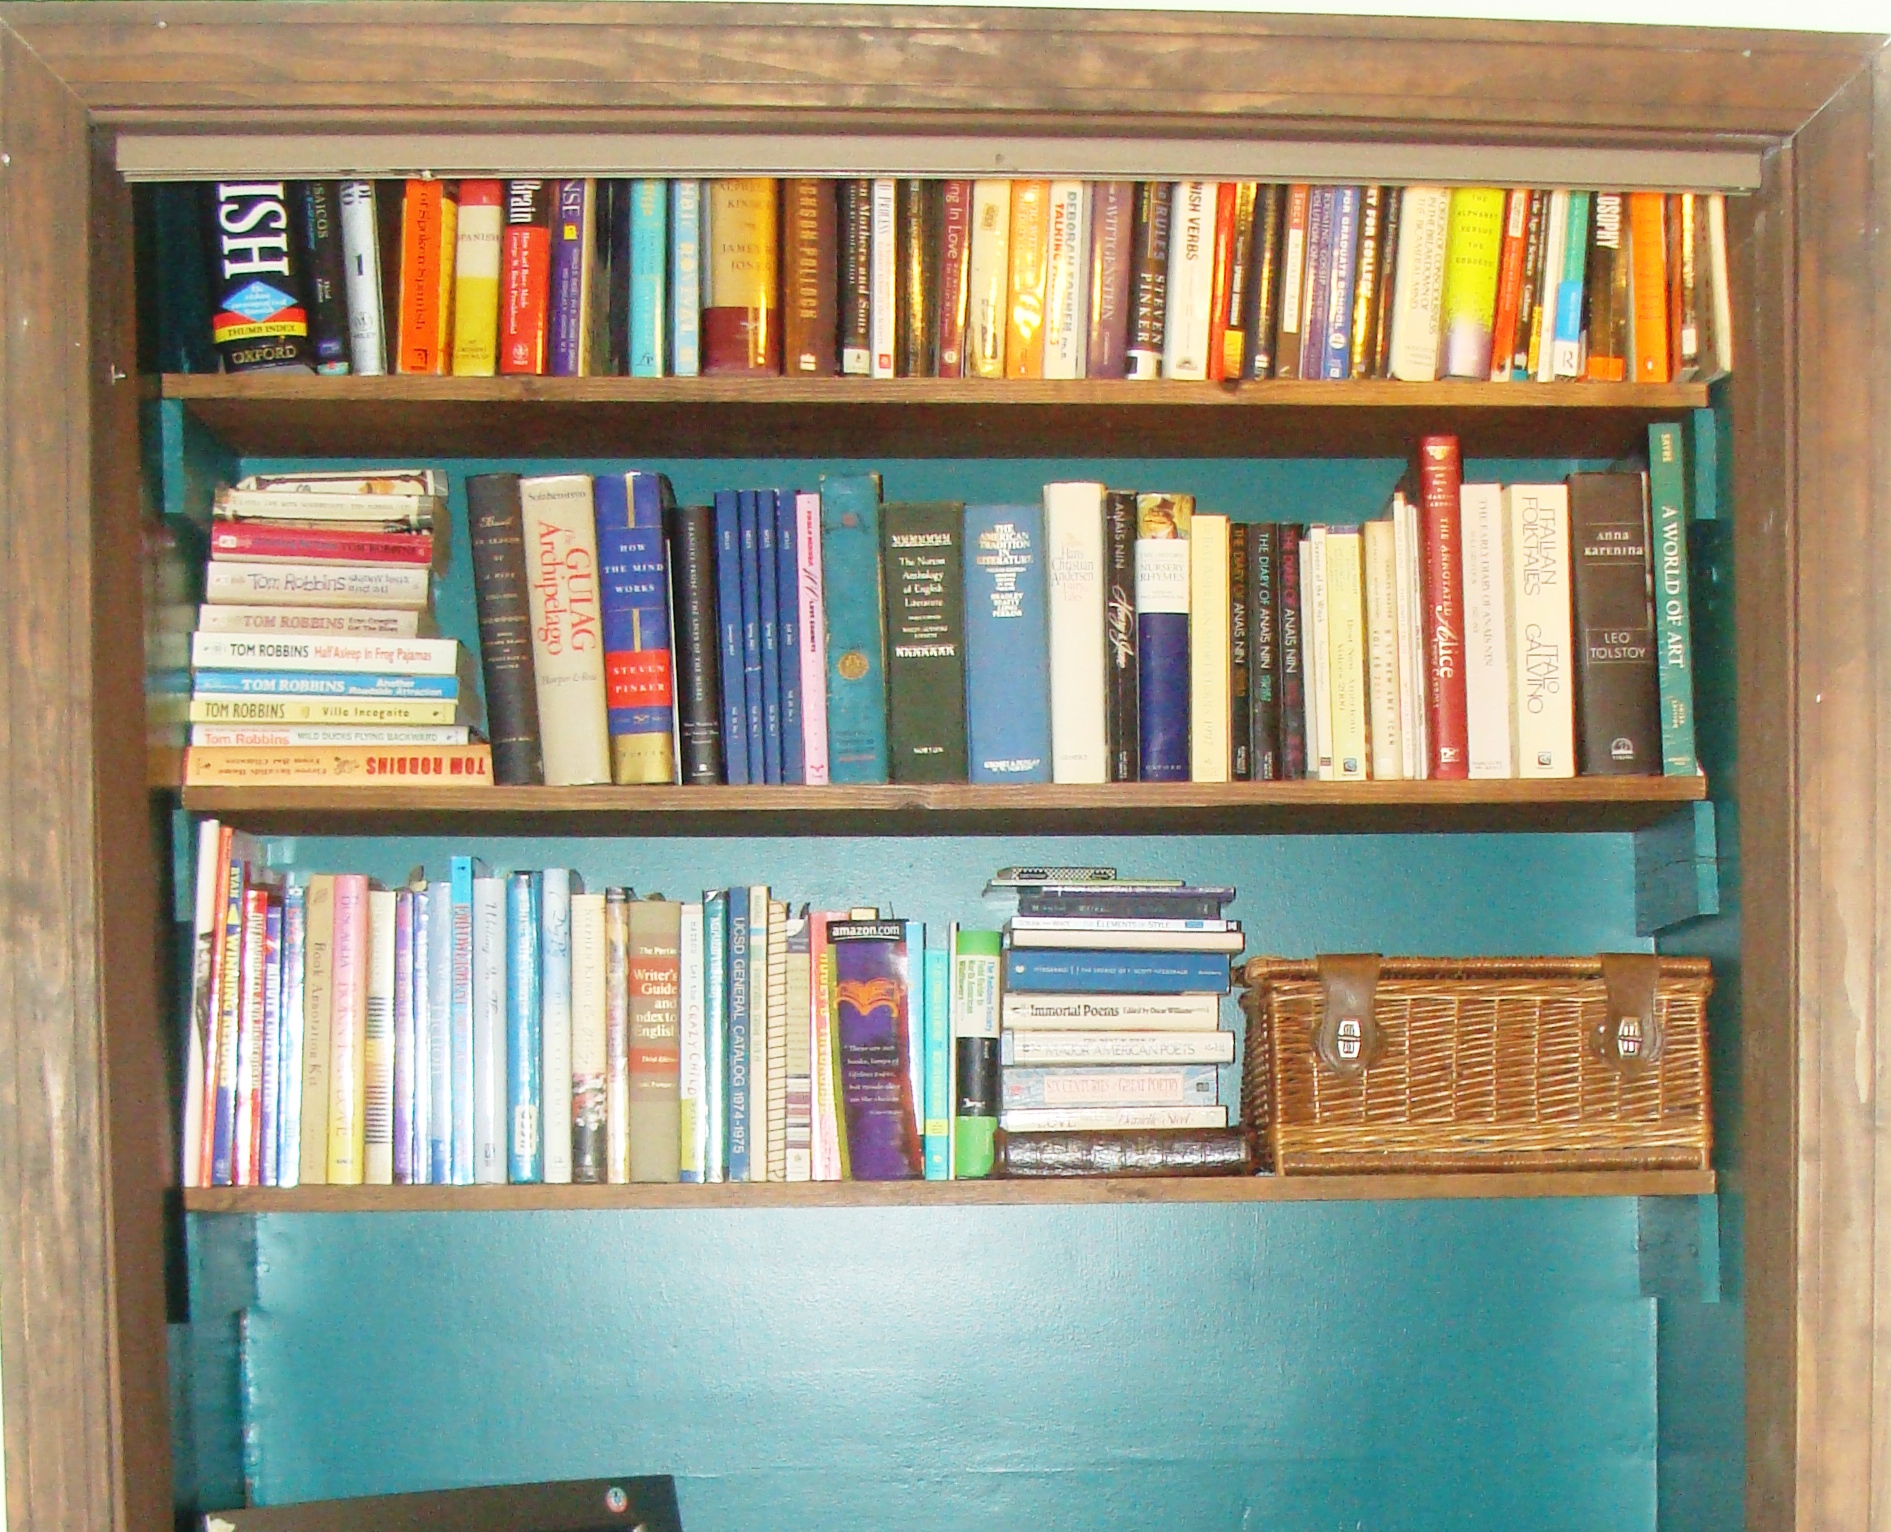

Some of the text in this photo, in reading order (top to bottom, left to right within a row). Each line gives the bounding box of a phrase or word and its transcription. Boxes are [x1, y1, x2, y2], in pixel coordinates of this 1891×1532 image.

[509, 180, 542, 223] Brain
[950, 208, 962, 220] In
[1595, 196, 1621, 249] OSOPHY
[1065, 191, 1078, 267] DEBORAH
[1185, 217, 1201, 262] VERBS
[946, 224, 962, 260] Love
[1359, 209, 1376, 298] FOR COLLEGE
[413, 211, 431, 331] Spoken Spanish
[857, 203, 871, 335] Mothers and Sons
[1333, 190, 1353, 330] FOR GRADUATE SCHOOL
[799, 247, 818, 319] POLLOCK
[1137, 273, 1153, 343] PINKER
[1151, 274, 1166, 345] STEVEN
[231, 345, 297, 365] OXFORD
[619, 543, 647, 553] HOW
[1258, 533, 1269, 553] THE
[1522, 497, 1541, 597] FOLKTALES
[1539, 508, 1558, 586] ITALIAN
[605, 563, 664, 574] THE MIND
[899, 557, 915, 567] The
[1114, 544, 1126, 569] NIN
[248, 572, 346, 592] Tom Robbins
[1258, 556, 1269, 588] DIARY
[535, 521, 567, 657] Archipelago
[615, 583, 656, 594] WORKS
[1435, 517, 1460, 679] THE ANNOTATED Alice
[1661, 505, 1685, 669] A WORLD OF ART
[565, 547, 596, 652] GULAG
[244, 614, 345, 630] TOM ROBBINS
[230, 643, 256, 657] TOM
[259, 642, 309, 658] ROBBINS
[1603, 633, 1631, 645] LEO
[1233, 640, 1245, 664] NIN
[1259, 646, 1270, 669] NIN
[1285, 649, 1298, 673] NIN
[1589, 647, 1646, 660] TOLSTOY
[614, 663, 665, 674] STEVEN
[1525, 624, 1545, 714] CALVINO
[1540, 644, 1560, 693] ITALO
[241, 678, 277, 692] TOM
[280, 678, 346, 693] ROBBINS
[615, 683, 665, 692] PINKER
[205, 702, 230, 719] TOM
[233, 702, 285, 719] ROBBINS
[205, 734, 232, 746] Tom
[236, 734, 291, 747] Robbins
[365, 757, 486, 776] TOM ROBBINS
[831, 924, 900, 938] amazon.com
[640, 983, 678, 997] Guide
[307, 942, 327, 1088] Book Annotation Kit
[654, 998, 677, 1009] and
[1030, 1003, 1120, 1018] Immortal Poems
[636, 1012, 664, 1024] ndex
[732, 916, 747, 1154] UCSD GENERAL CATALOG 1974-1975
[687, 1003, 703, 1096] CRAZY CHILD
[1091, 1044, 1159, 1057] AMERICAN
[1159, 1044, 1196, 1057] POETS
